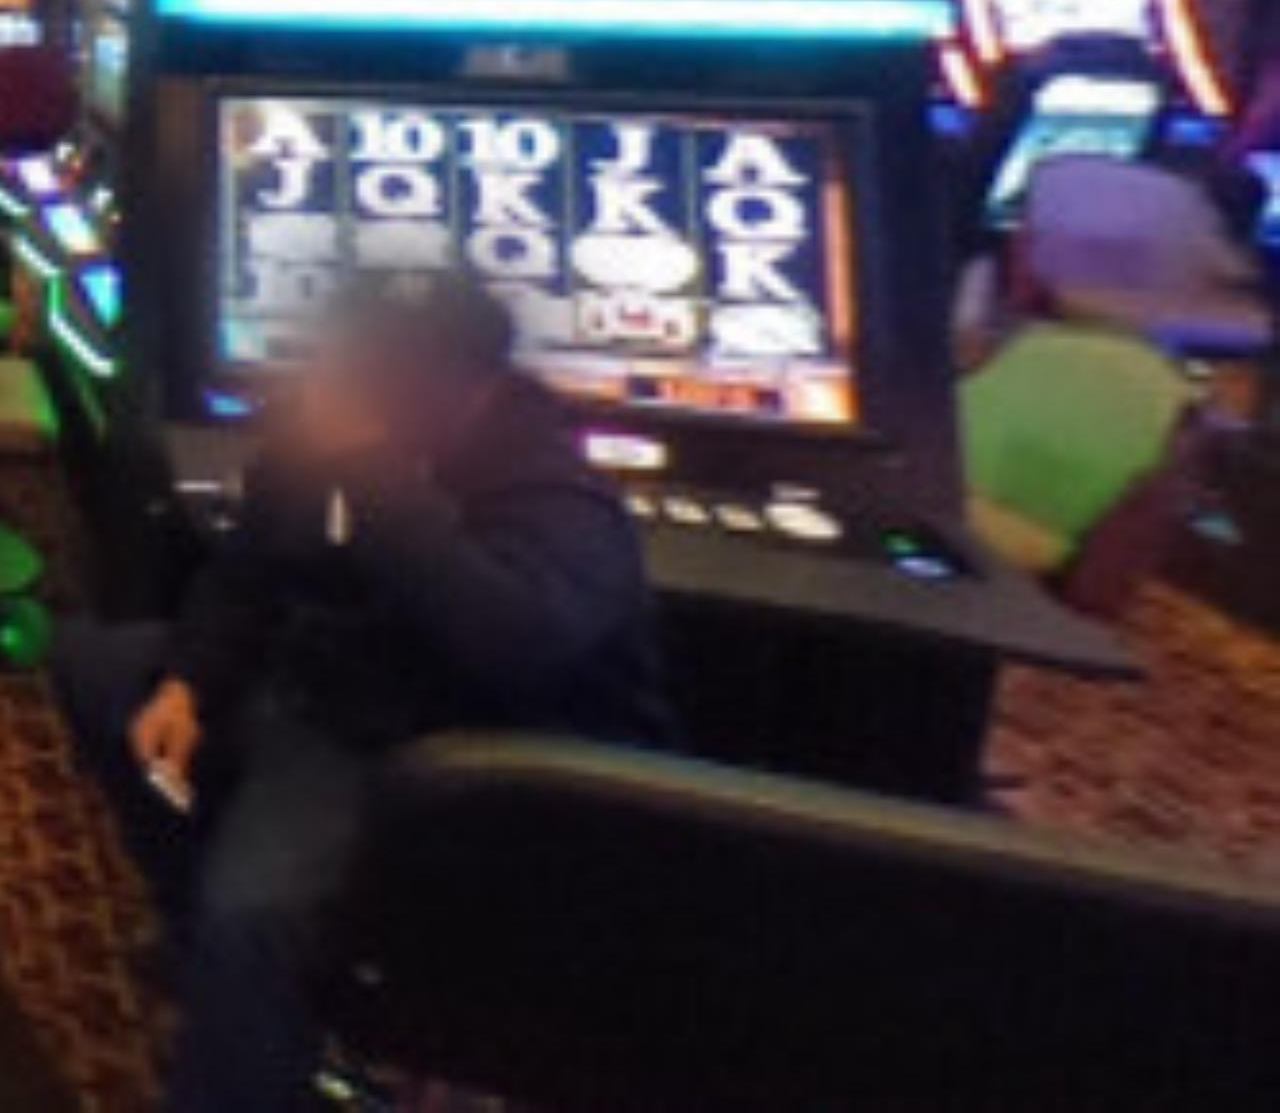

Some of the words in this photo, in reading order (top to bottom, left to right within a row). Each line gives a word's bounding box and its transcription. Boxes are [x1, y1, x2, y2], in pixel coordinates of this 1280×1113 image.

[248, 102, 330, 160] A
[349, 110, 442, 162] 10
[457, 119, 559, 170] 10
[588, 121, 652, 175] J
[702, 132, 810, 185] A
[256, 158, 314, 208] J
[354, 165, 443, 216] Q
[474, 170, 552, 227] K
[589, 172, 670, 232] K
[707, 188, 808, 240] Q
[466, 226, 556, 278] Q
[717, 240, 806, 302] K
